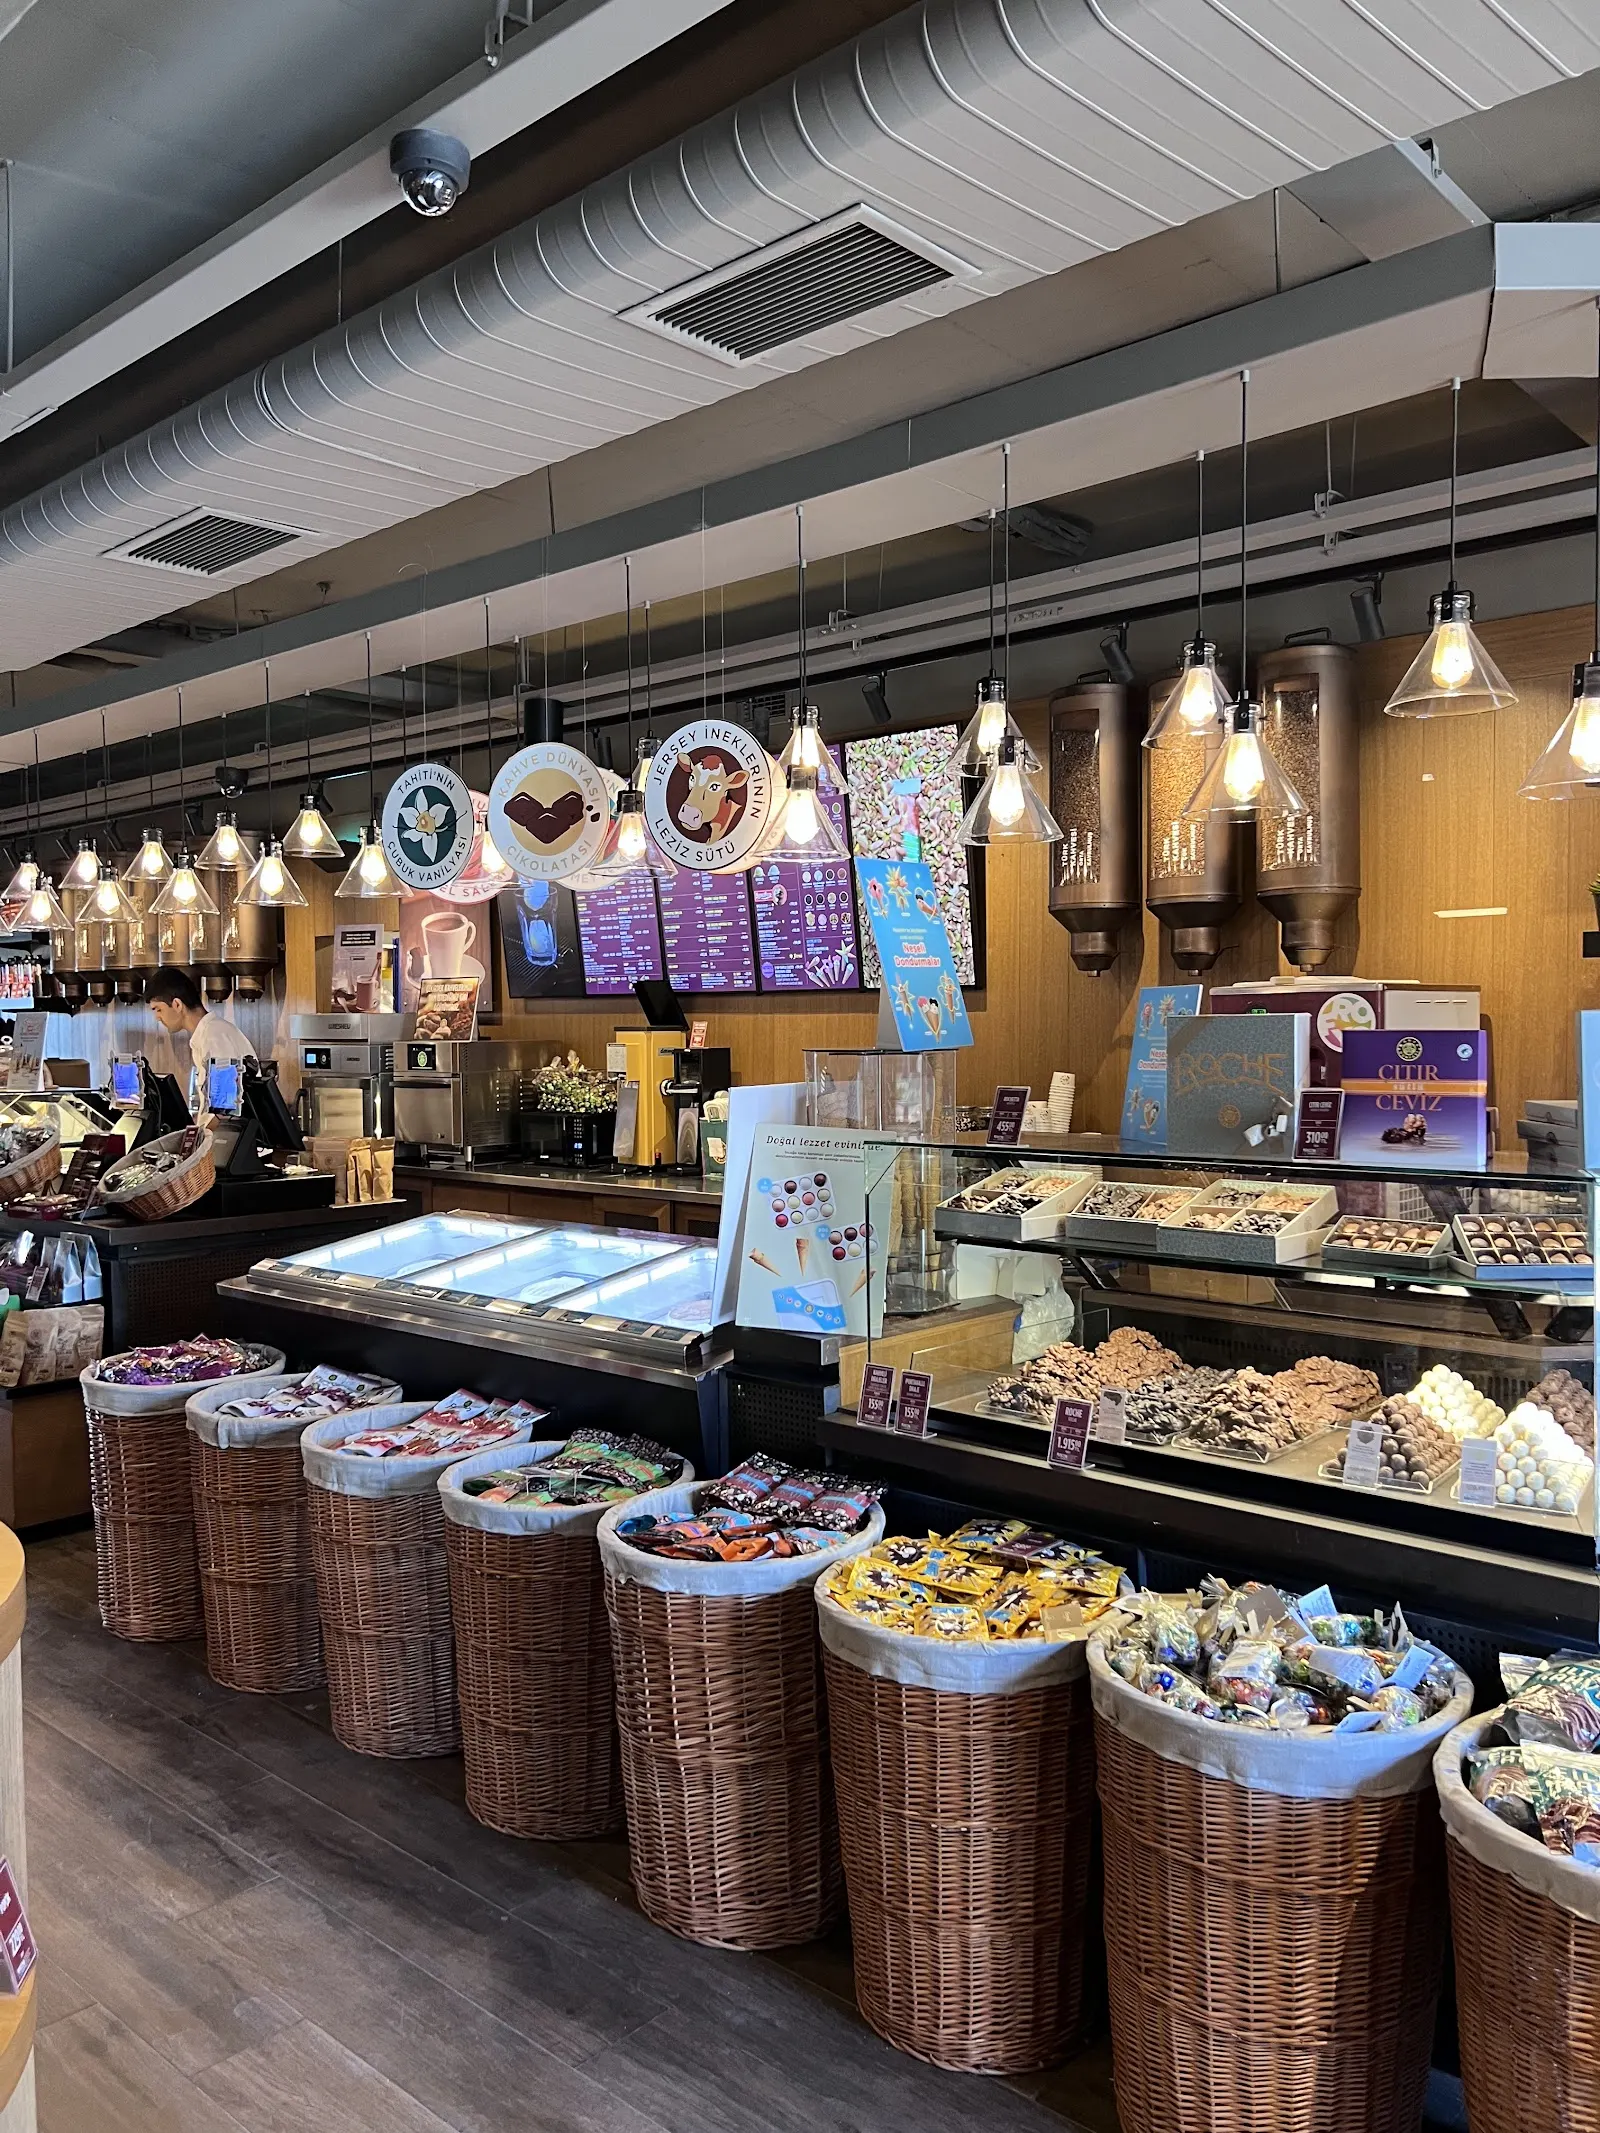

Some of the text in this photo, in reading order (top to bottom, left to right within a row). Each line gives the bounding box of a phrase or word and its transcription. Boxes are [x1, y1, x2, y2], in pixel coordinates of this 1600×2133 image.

[397, 767, 455, 794] TAHİTİ'NİN
[498, 751, 600, 803] KAHVE DÜNYASI
[653, 725, 766, 819] JERSEY İNEKLERİNİN
[387, 836, 468, 882] ÇUBUK VANİLYASI
[507, 839, 592, 873] ÇİKOLATASI
[654, 818, 690, 858] LEZİZ
[695, 840, 736, 862] SÜTÜ
[894, 955, 941, 967] Dondurmalar
[1175, 1051, 1290, 1097] ROCHE
[766, 1135, 796, 1147] Doğal
[799, 1137, 831, 1148] lezzet
